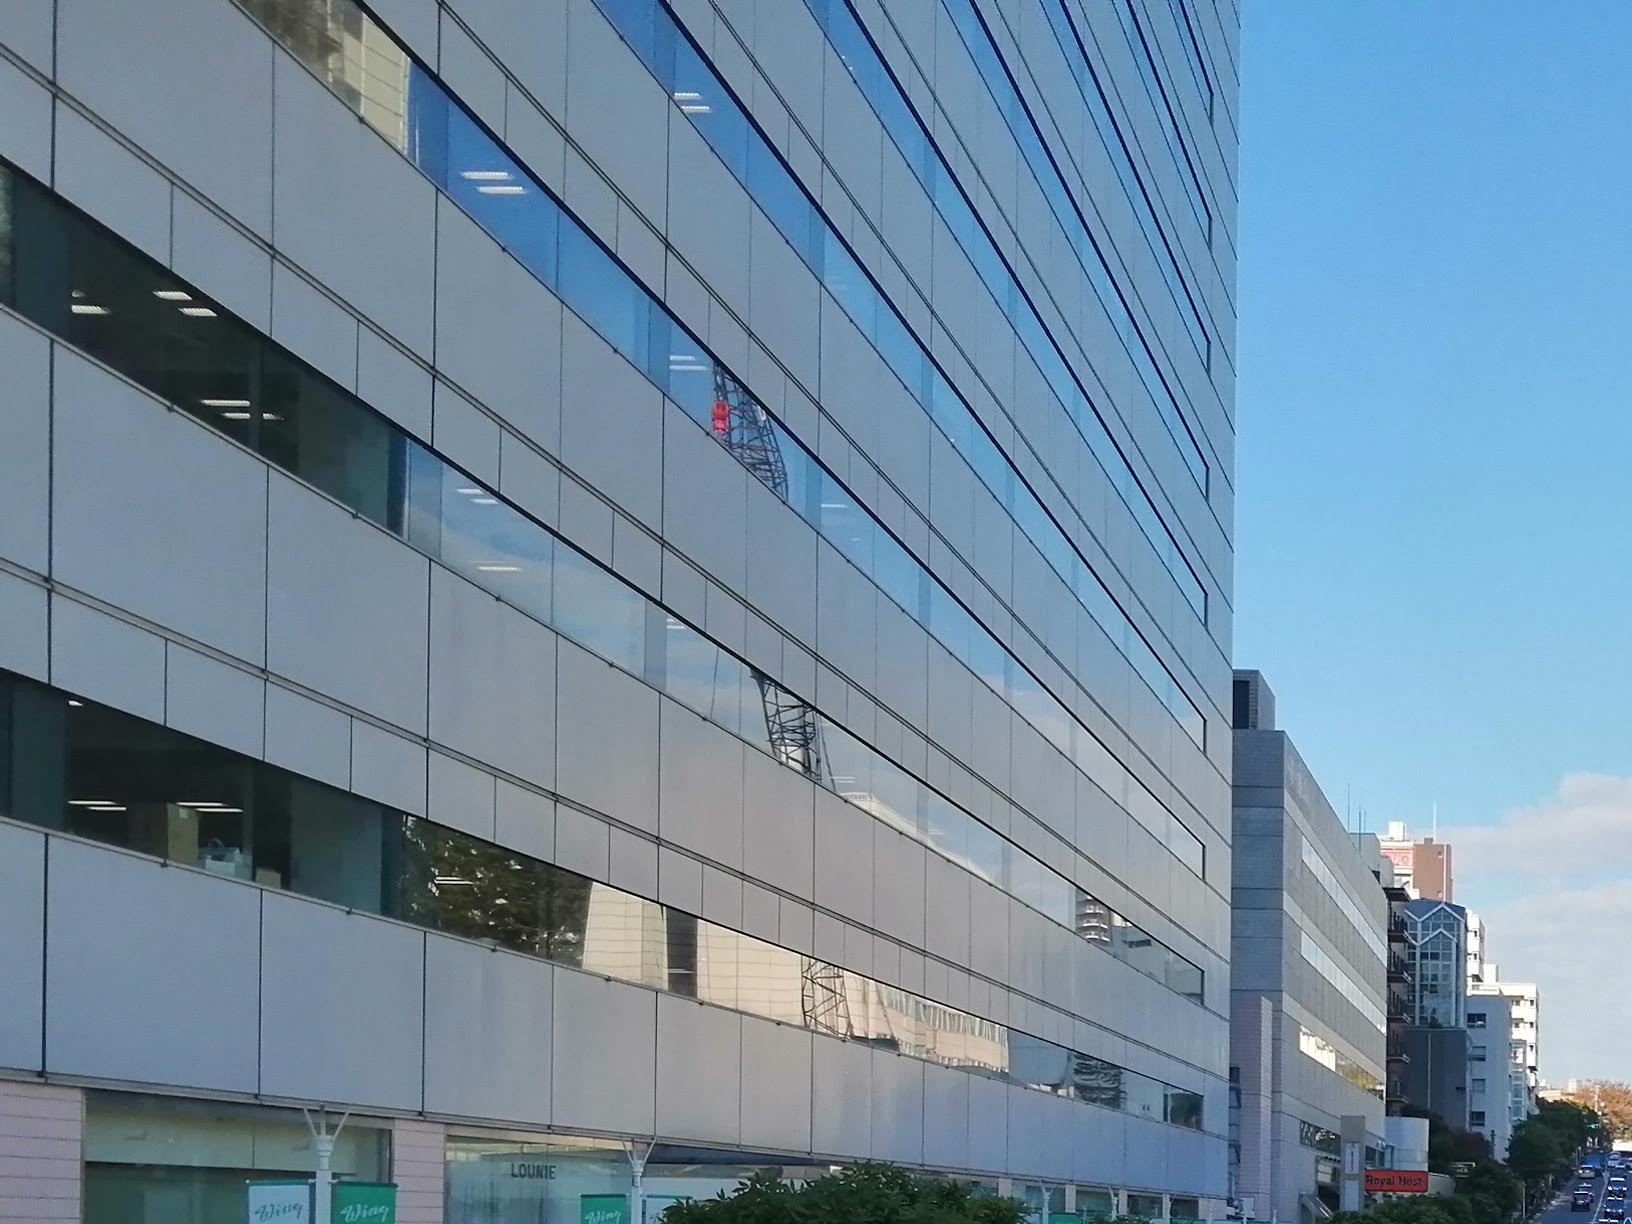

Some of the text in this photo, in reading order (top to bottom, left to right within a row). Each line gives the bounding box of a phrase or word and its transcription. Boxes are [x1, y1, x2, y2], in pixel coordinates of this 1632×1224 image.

[511, 1162, 557, 1180] LOUNIE
[1365, 1174, 1423, 1187] Royal Host
[254, 1202, 303, 1222] Wing
[340, 1203, 390, 1223] Wing
